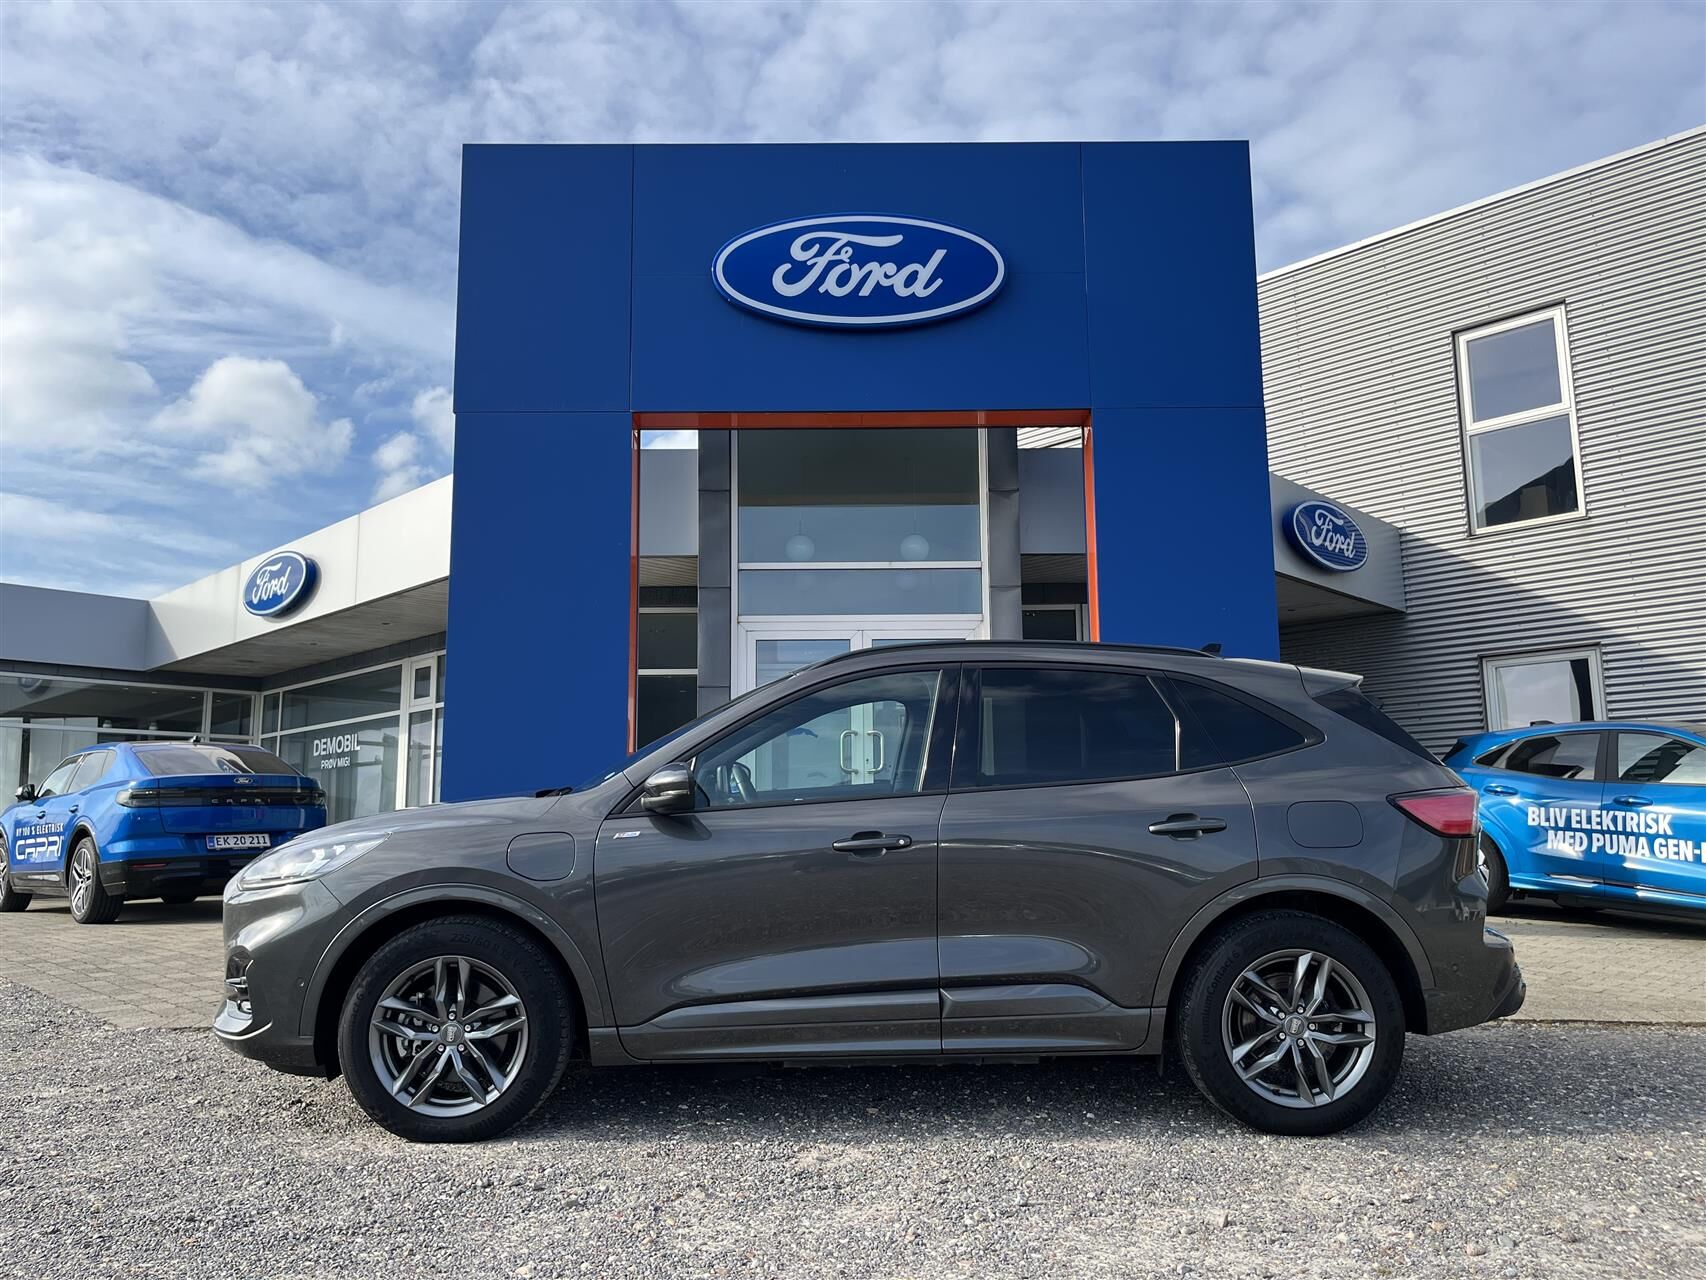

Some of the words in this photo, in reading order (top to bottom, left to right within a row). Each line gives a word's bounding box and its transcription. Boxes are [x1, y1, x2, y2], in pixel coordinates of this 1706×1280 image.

[772, 231, 947, 297] Ford
[1311, 509, 1355, 558] Ford
[252, 562, 292, 604] Ford
[313, 733, 361, 756] DEMOBIL
[36, 823, 64, 835] ELEKTRISK
[1527, 806, 1568, 828] BLIV
[1571, 808, 1673, 836] ELEKTRISK
[216, 836, 230, 846] EK
[233, 836, 246, 845] 20
[249, 836, 267, 845] 211
[1547, 830, 1588, 852] MED
[1592, 833, 1650, 858] PUMA
